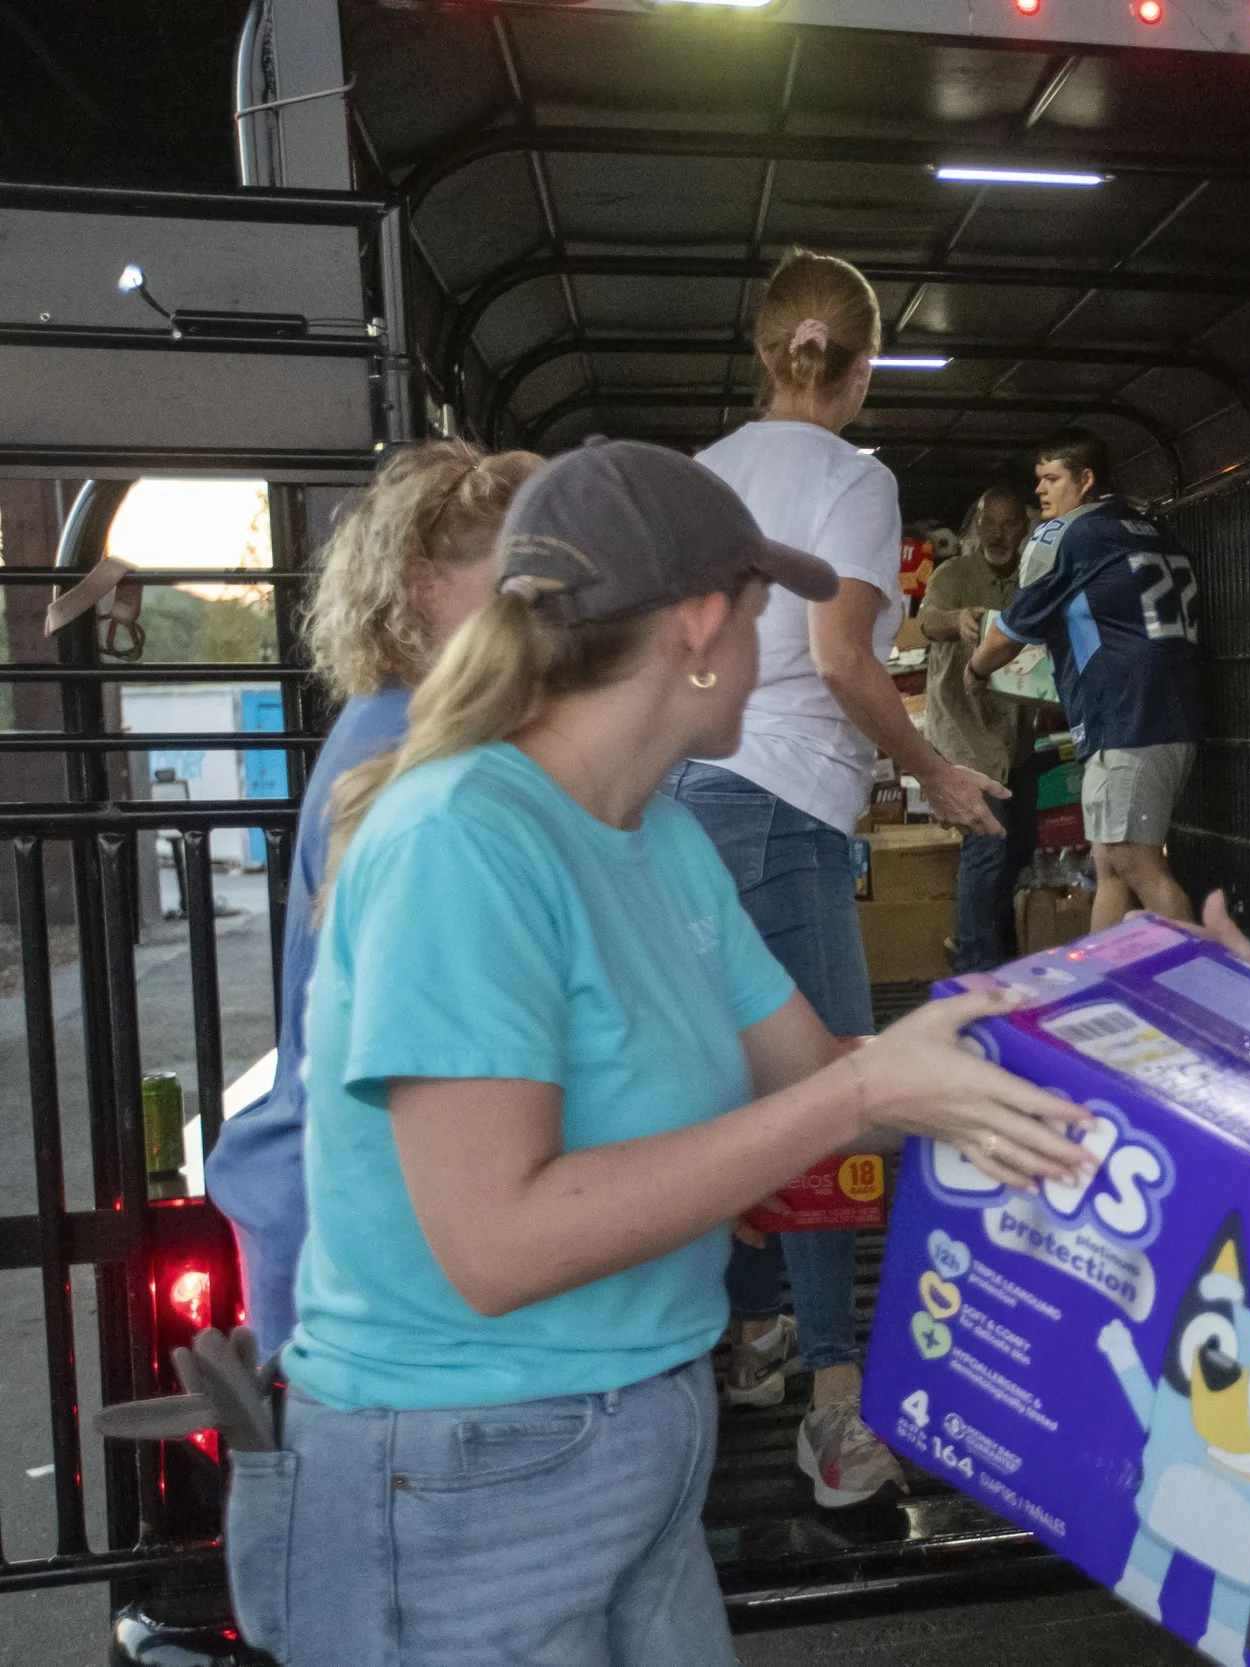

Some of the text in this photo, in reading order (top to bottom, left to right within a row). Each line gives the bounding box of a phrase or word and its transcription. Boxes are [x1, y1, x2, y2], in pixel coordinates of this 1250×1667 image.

[849, 1160, 875, 1186] 18
[1001, 1211, 1138, 1303] protection
[902, 1389, 930, 1428] 4
[932, 1436, 974, 1478] 164
